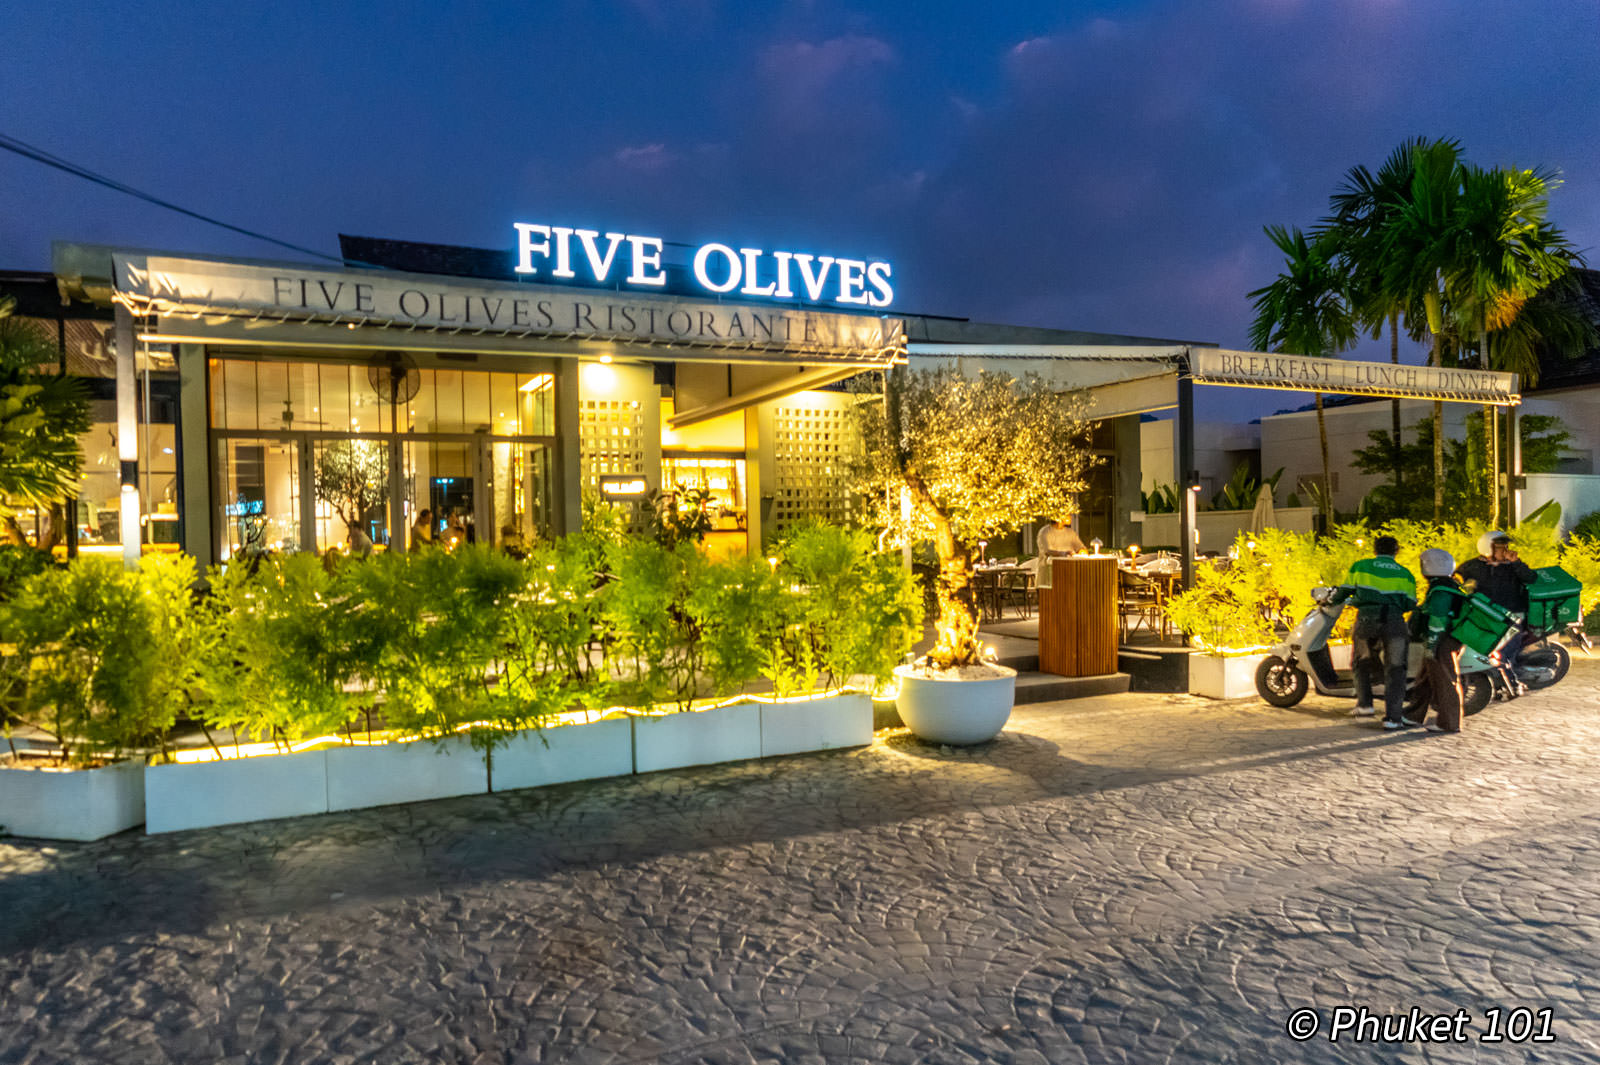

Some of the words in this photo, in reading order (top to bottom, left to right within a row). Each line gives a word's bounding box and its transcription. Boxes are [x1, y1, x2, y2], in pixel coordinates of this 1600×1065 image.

[513, 222, 666, 286] FIVE
[693, 243, 893, 307] OLIVES
[272, 277, 375, 313] FIVE
[399, 289, 554, 329] OLIVES
[573, 302, 818, 342] RISTORANTE
[1220, 354, 1332, 382] BREAKFAST
[1355, 366, 1417, 388] LUNCH
[1437, 371, 1499, 392] DINNER
